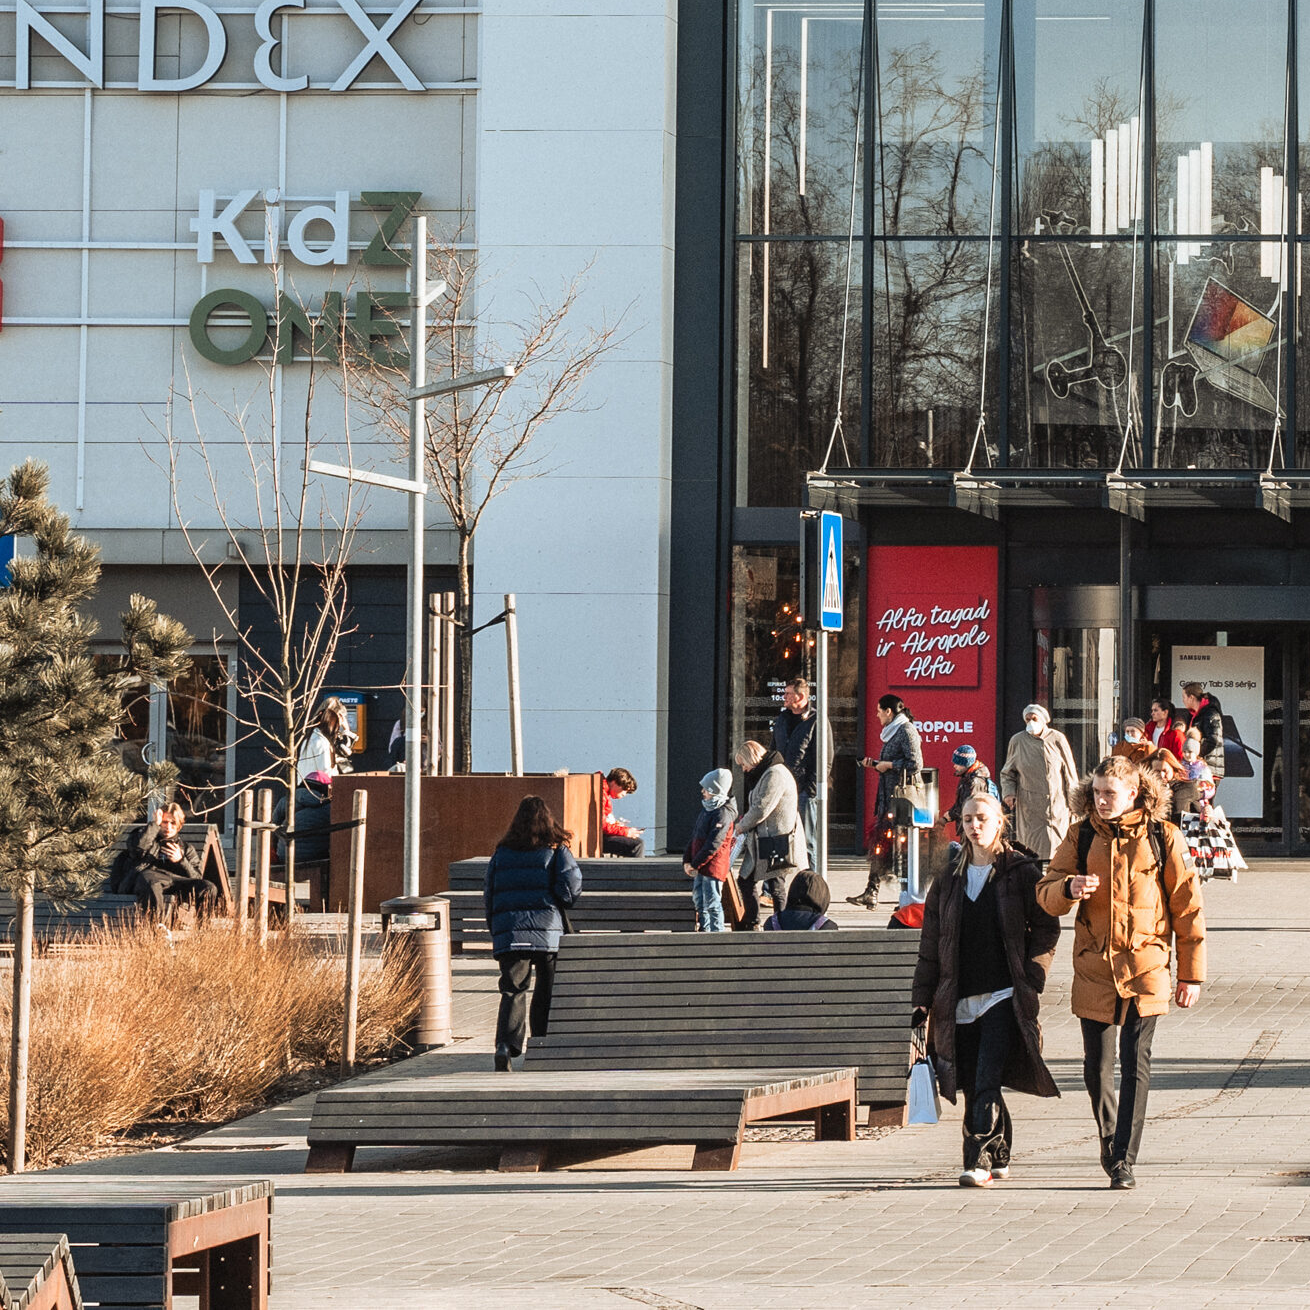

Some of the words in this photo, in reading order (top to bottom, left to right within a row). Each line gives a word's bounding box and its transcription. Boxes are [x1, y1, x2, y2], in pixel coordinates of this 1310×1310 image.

[189, 289, 412, 366] ONE
[876, 607, 927, 632] Alfa
[931, 599, 990, 629] tagad
[876, 638, 895, 657] ir
[901, 624, 990, 655] Akropole
[904, 655, 955, 680] Alfa
[1209, 680, 1223, 688] Tab
[1224, 680, 1234, 688] S8
[913, 721, 973, 733] ROPOLE
[920, 735, 949, 743] LFA
